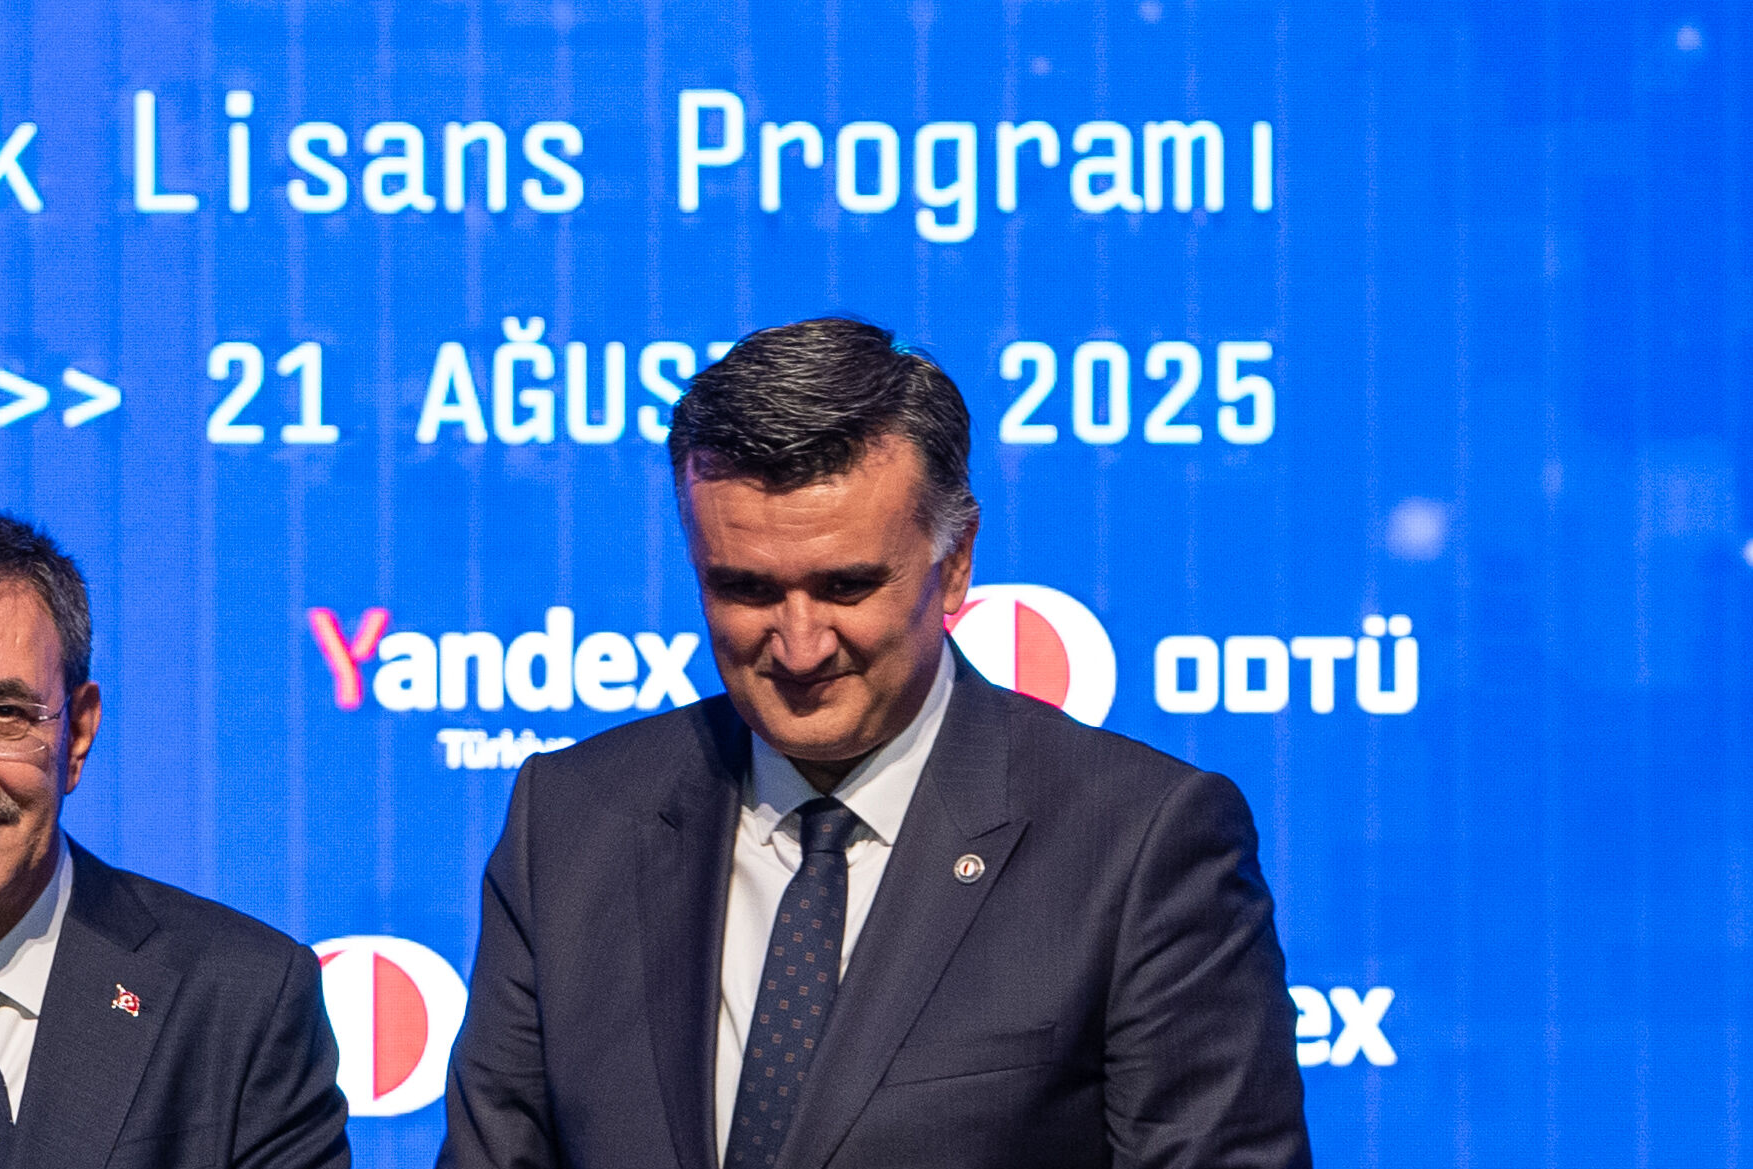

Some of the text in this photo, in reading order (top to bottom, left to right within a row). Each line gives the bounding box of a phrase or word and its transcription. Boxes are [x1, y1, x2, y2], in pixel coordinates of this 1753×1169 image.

[134, 89, 585, 214] Lisans
[678, 89, 1273, 243] Programı
[206, 340, 339, 445] 21
[416, 315, 736, 445] AĞUS
[999, 340, 1274, 445] 2025
[308, 606, 701, 713] Yandex
[1154, 613, 1419, 715] ODTÜ
